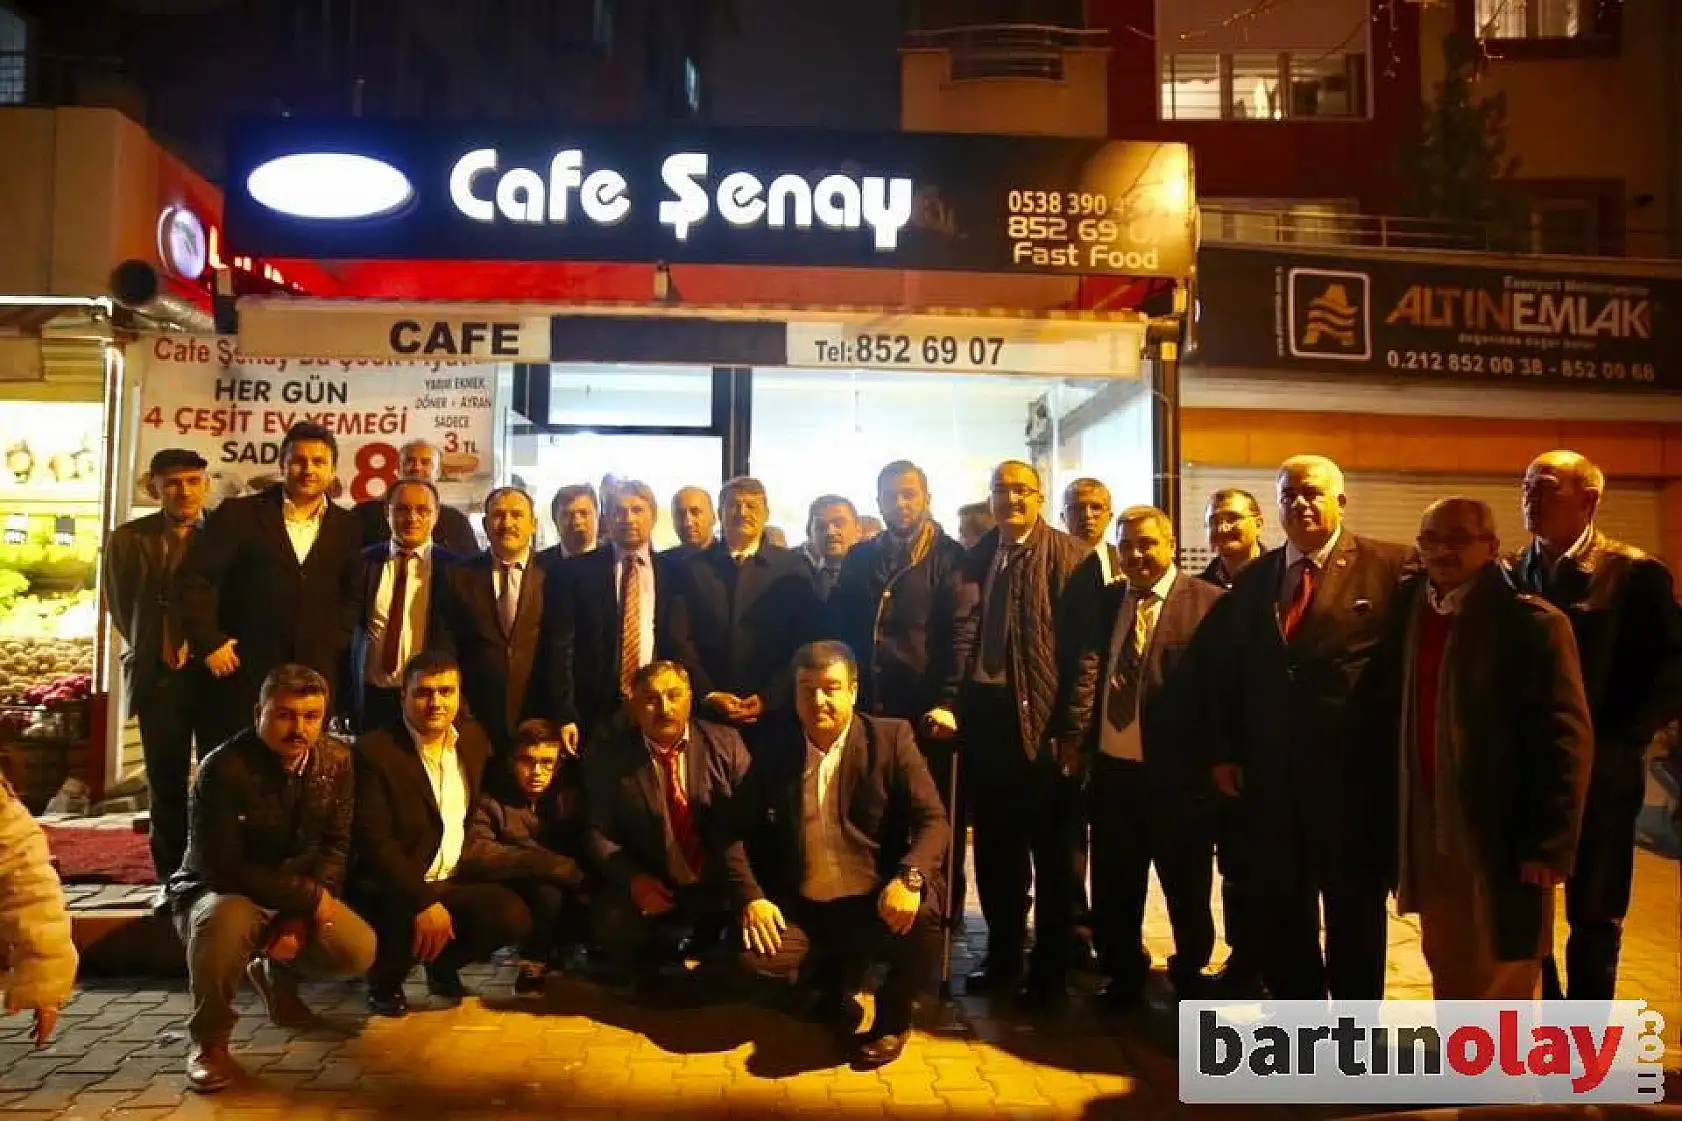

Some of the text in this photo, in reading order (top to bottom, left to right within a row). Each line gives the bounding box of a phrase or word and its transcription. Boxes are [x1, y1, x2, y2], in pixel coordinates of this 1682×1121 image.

[449, 148, 911, 251] Cafe Şenay
[1008, 190, 1061, 214] 0538
[1067, 193, 1107, 215] 390
[1008, 216, 1067, 240] 852
[1079, 218, 1118, 242] 69
[1013, 241, 1158, 269] Fast Food
[154, 337, 210, 363] Cafe
[390, 320, 520, 355] CAFE
[922, 336, 957, 364] 69
[969, 337, 1004, 365] 07
[1387, 349, 1444, 370] 0.212
[1449, 353, 1484, 373] 852
[1490, 355, 1514, 374] 00
[1602, 361, 1626, 380] 00
[215, 374, 347, 404] HER GÜN
[143, 405, 164, 429] 4
[175, 402, 252, 436] ÇEŞİT
[444, 432, 458, 453] 3
[220, 441, 400, 503] SAD 8
